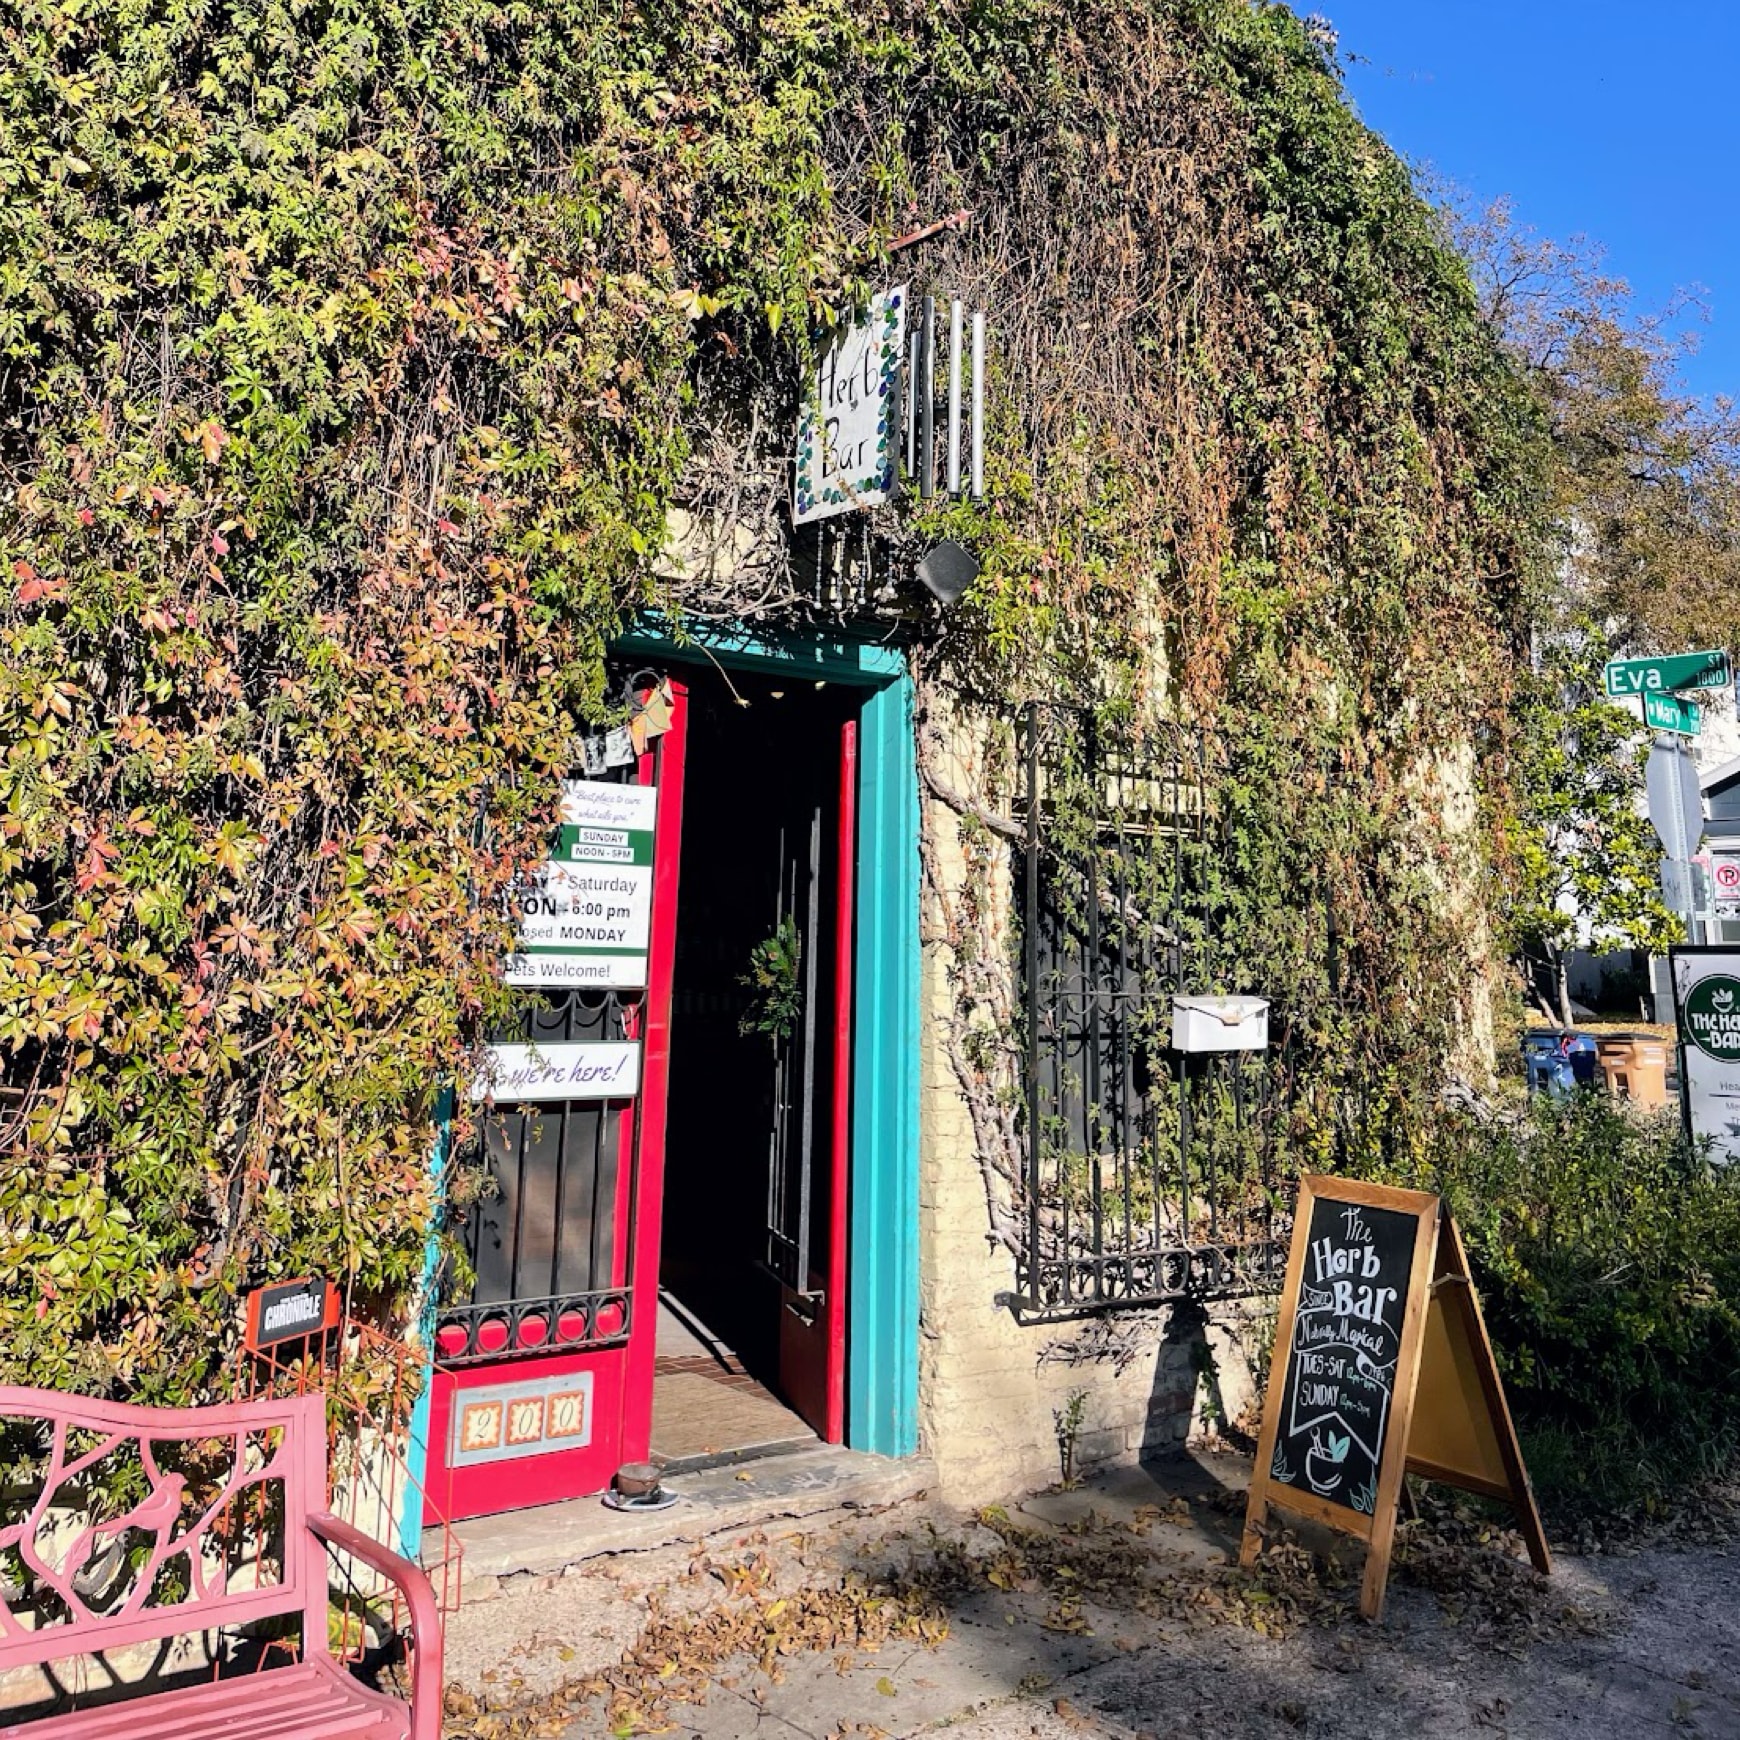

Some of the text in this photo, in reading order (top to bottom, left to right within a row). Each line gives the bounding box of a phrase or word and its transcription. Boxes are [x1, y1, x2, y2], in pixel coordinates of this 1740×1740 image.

[819, 347, 879, 408] Herb
[822, 417, 869, 478] Bar
[1708, 655, 1721, 668] ST
[1610, 666, 1662, 691] Eva
[1655, 700, 1681, 729] Mary
[583, 831, 624, 843] SUNDAY
[567, 875, 637, 896] Saturday
[606, 906, 631, 921] pm
[518, 925, 627, 941] losed MONDAY
[540, 962, 611, 977] Welcome!
[1691, 1013, 1719, 1030] THE
[568, 1054, 629, 1084] here!
[1340, 1207, 1373, 1242] The
[1312, 1236, 1381, 1282] Herb
[264, 1294, 322, 1331] CHRONICLE
[1332, 1280, 1398, 1325] Bar
[1336, 1317, 1384, 1356] Magical
[1300, 1380, 1339, 1407] SUNDAY
[475, 1401, 574, 1438] 200
